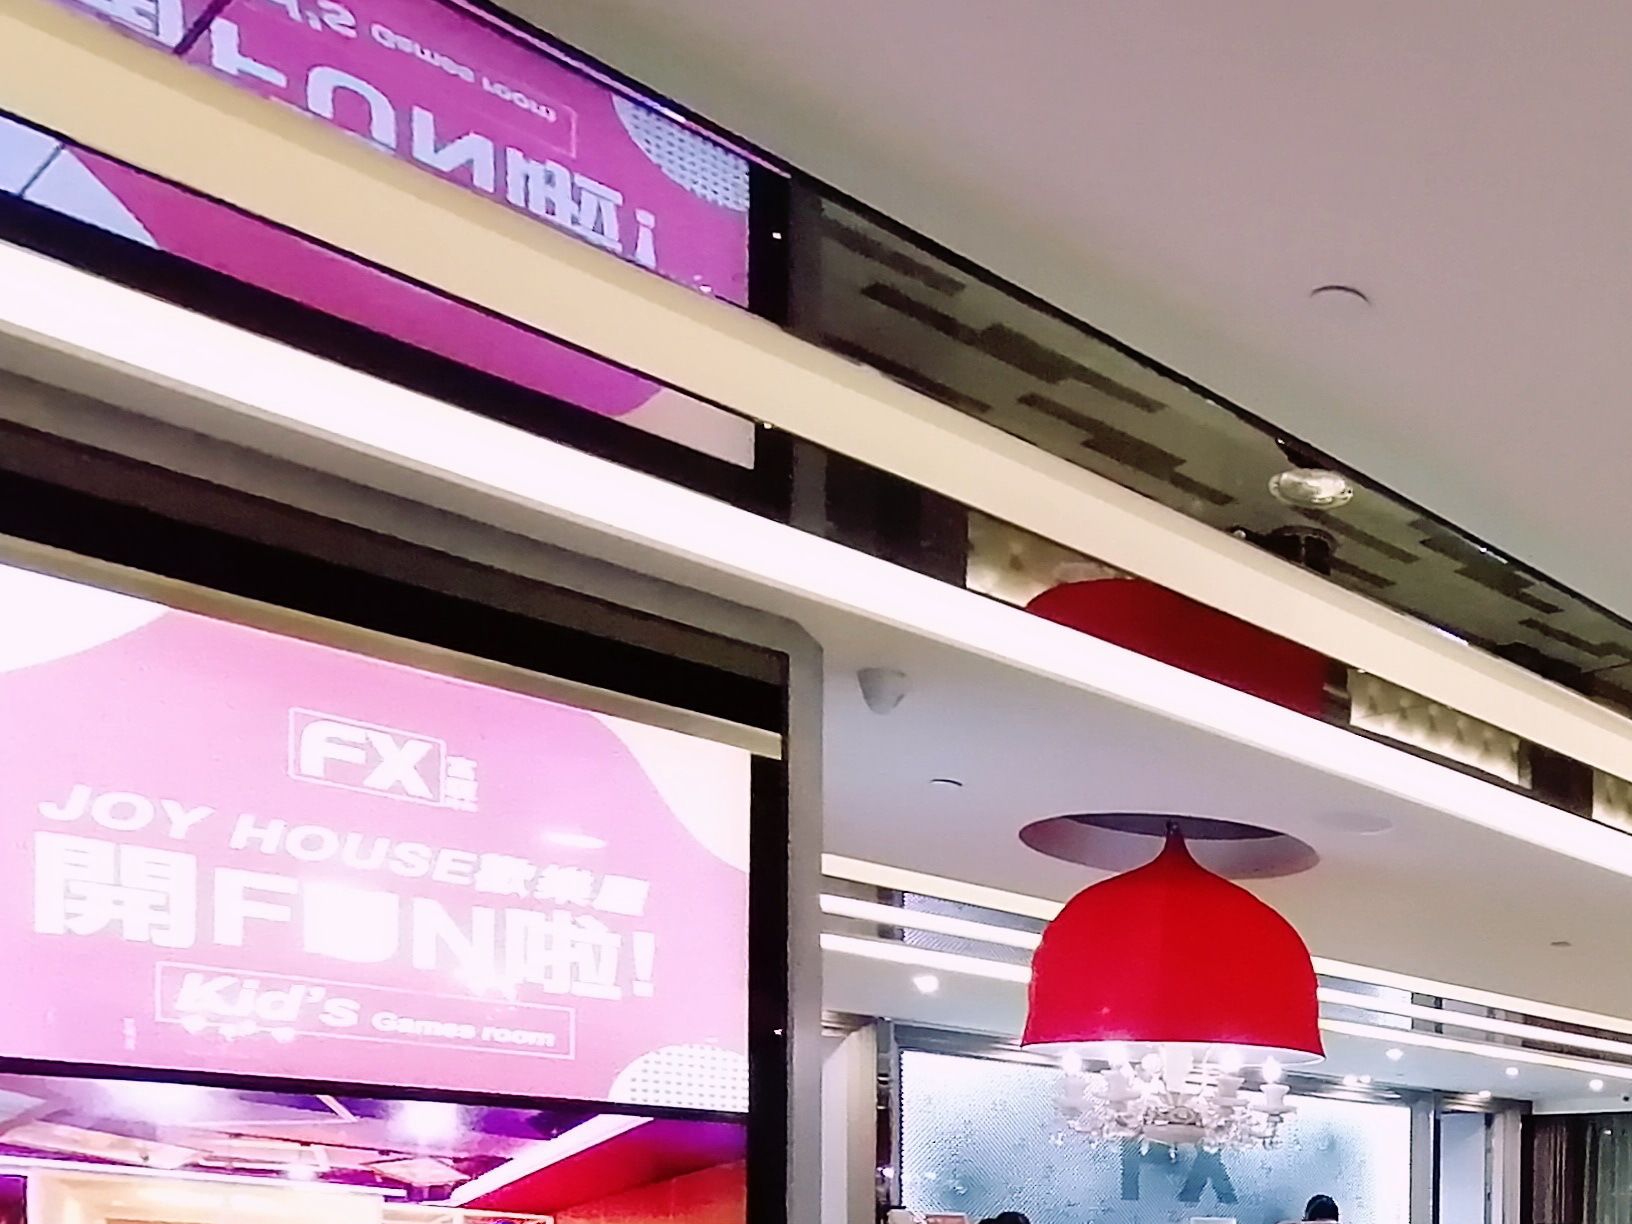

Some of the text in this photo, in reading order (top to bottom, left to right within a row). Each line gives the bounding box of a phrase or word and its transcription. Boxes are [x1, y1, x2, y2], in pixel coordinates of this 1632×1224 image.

[300, 718, 435, 800] FX
[38, 783, 216, 840] JOY
[175, 972, 557, 1048] Kid's Games room
